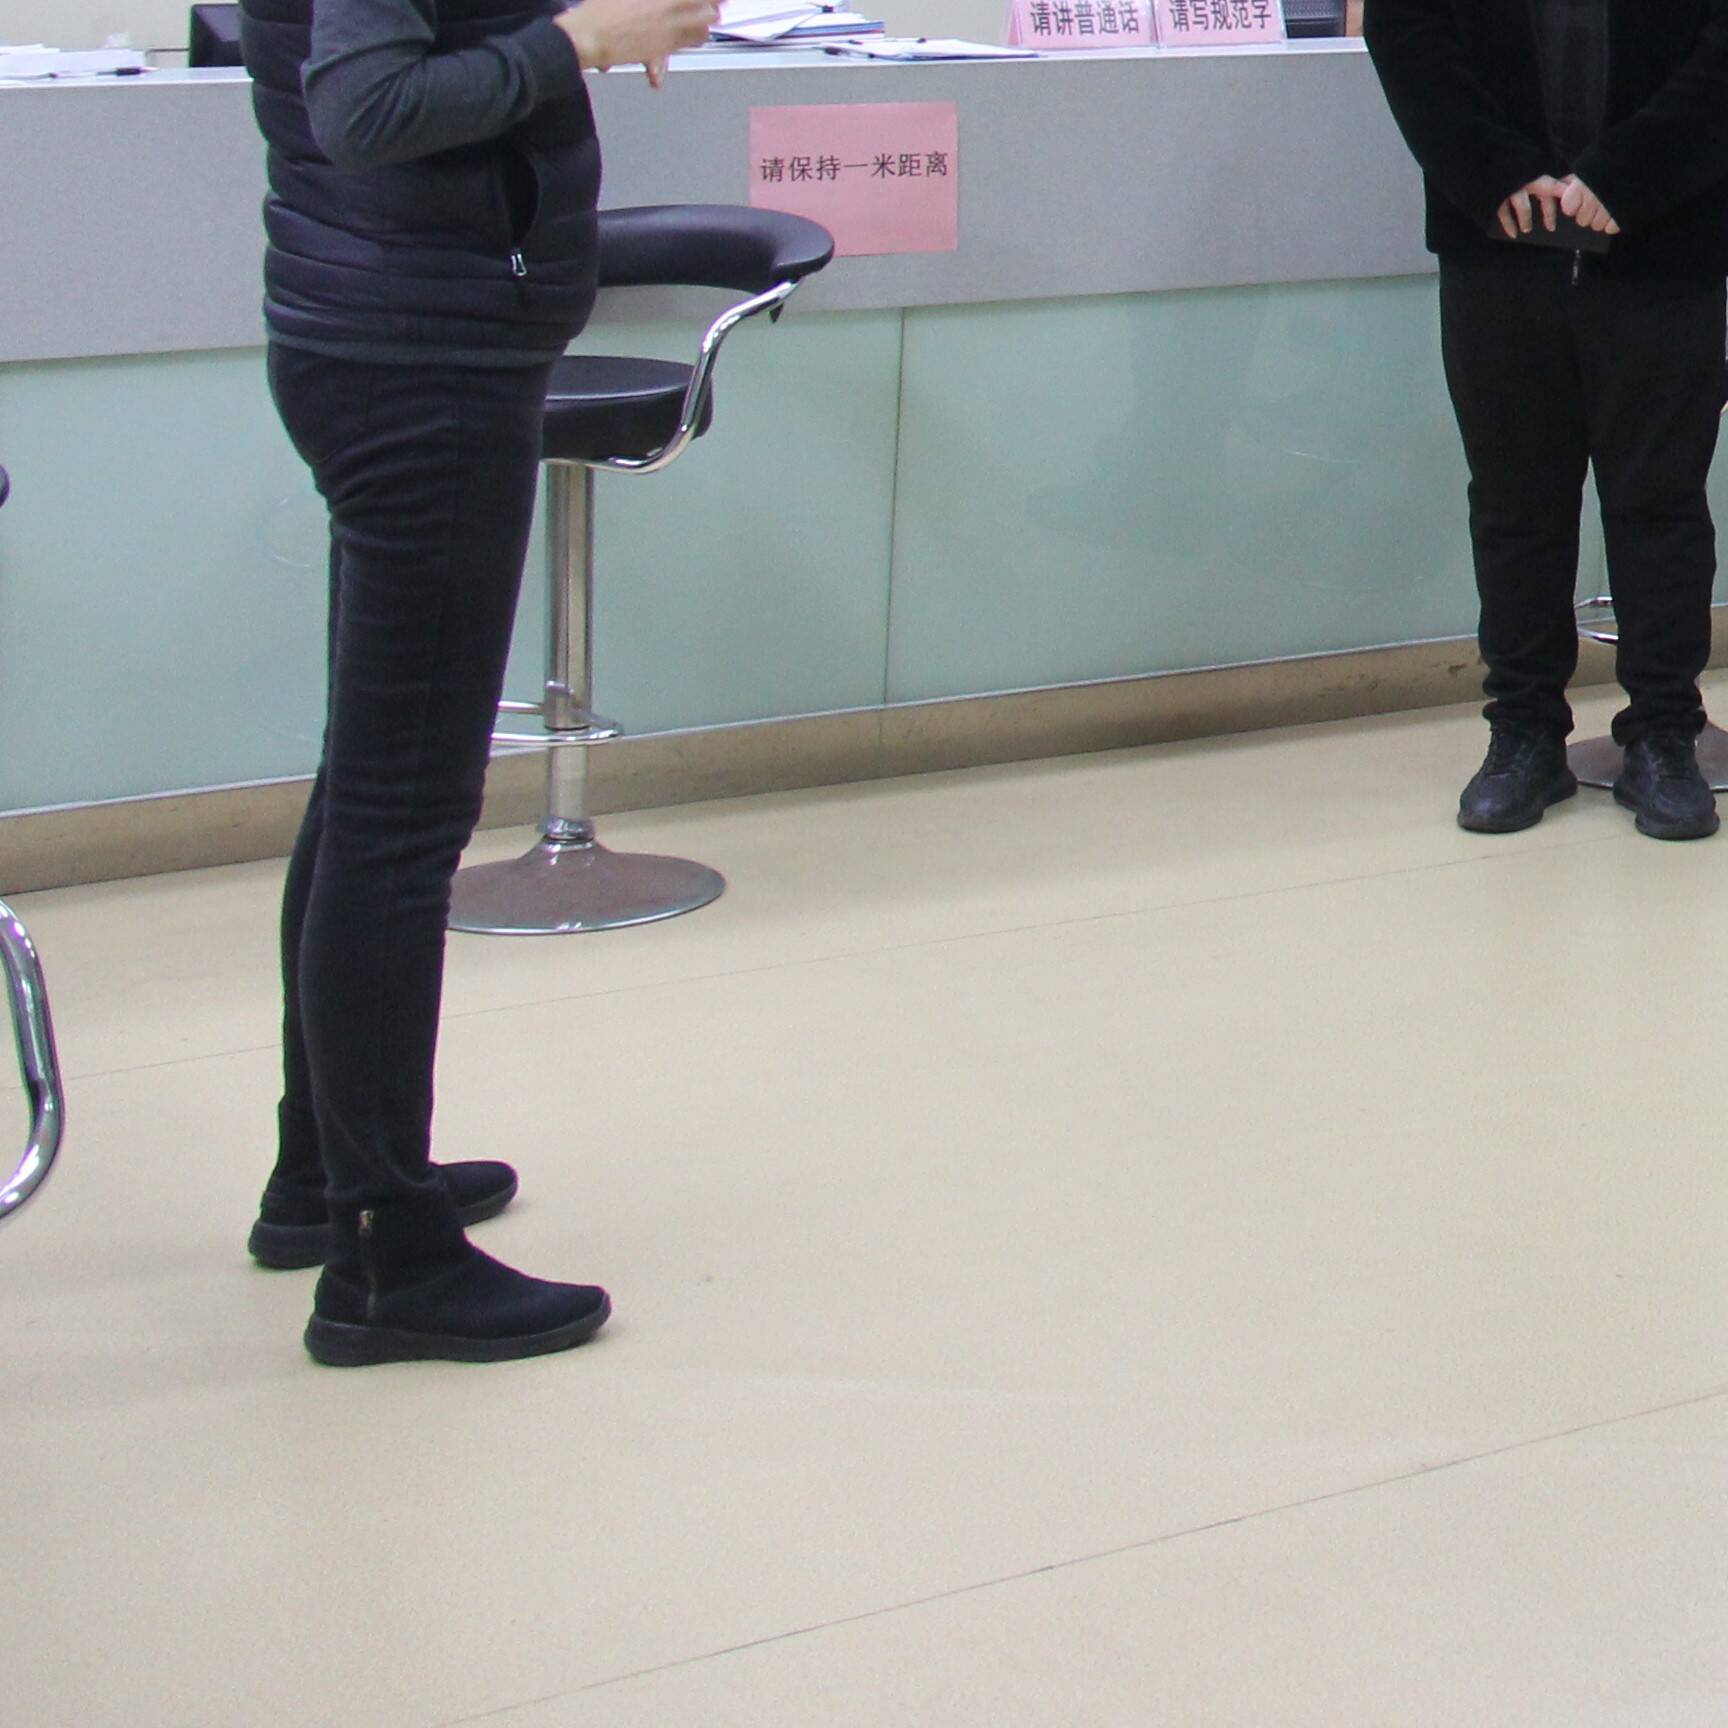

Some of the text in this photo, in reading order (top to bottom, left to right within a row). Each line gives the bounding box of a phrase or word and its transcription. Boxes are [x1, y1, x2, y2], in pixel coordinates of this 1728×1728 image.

[1030, 0, 1140, 35] 请讲普通话
[760, 151, 949, 183] 请保持一米距离
